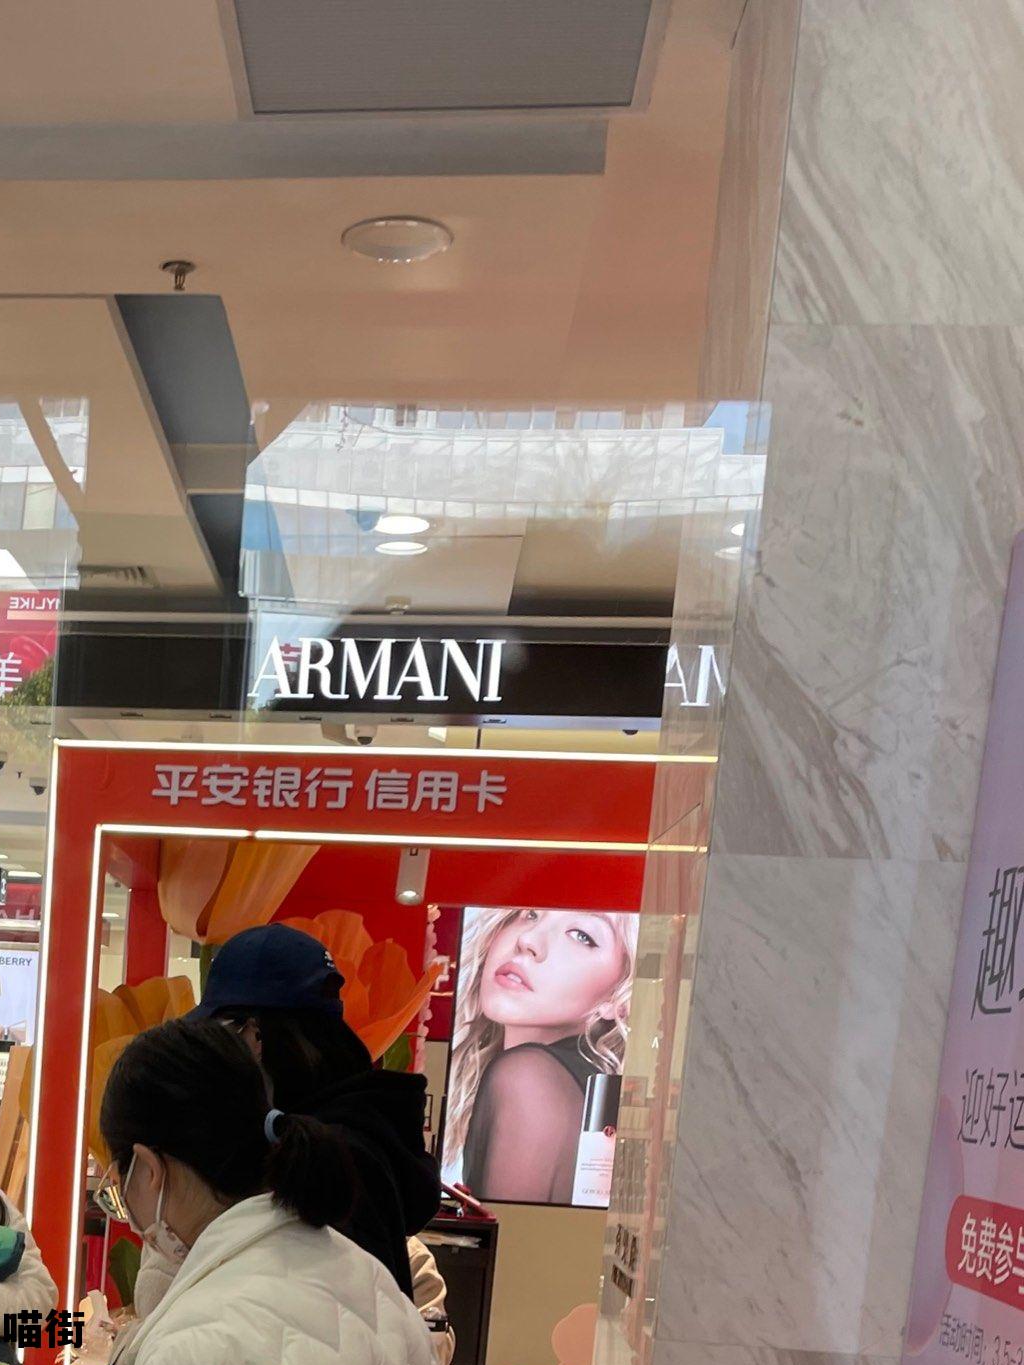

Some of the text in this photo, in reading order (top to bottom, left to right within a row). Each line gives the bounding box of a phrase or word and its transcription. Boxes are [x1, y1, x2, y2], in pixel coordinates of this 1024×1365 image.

[247, 635, 506, 701] ARMANI
[152, 763, 507, 812] 平安银行 信用卡
[970, 866, 1024, 1021] 趣
